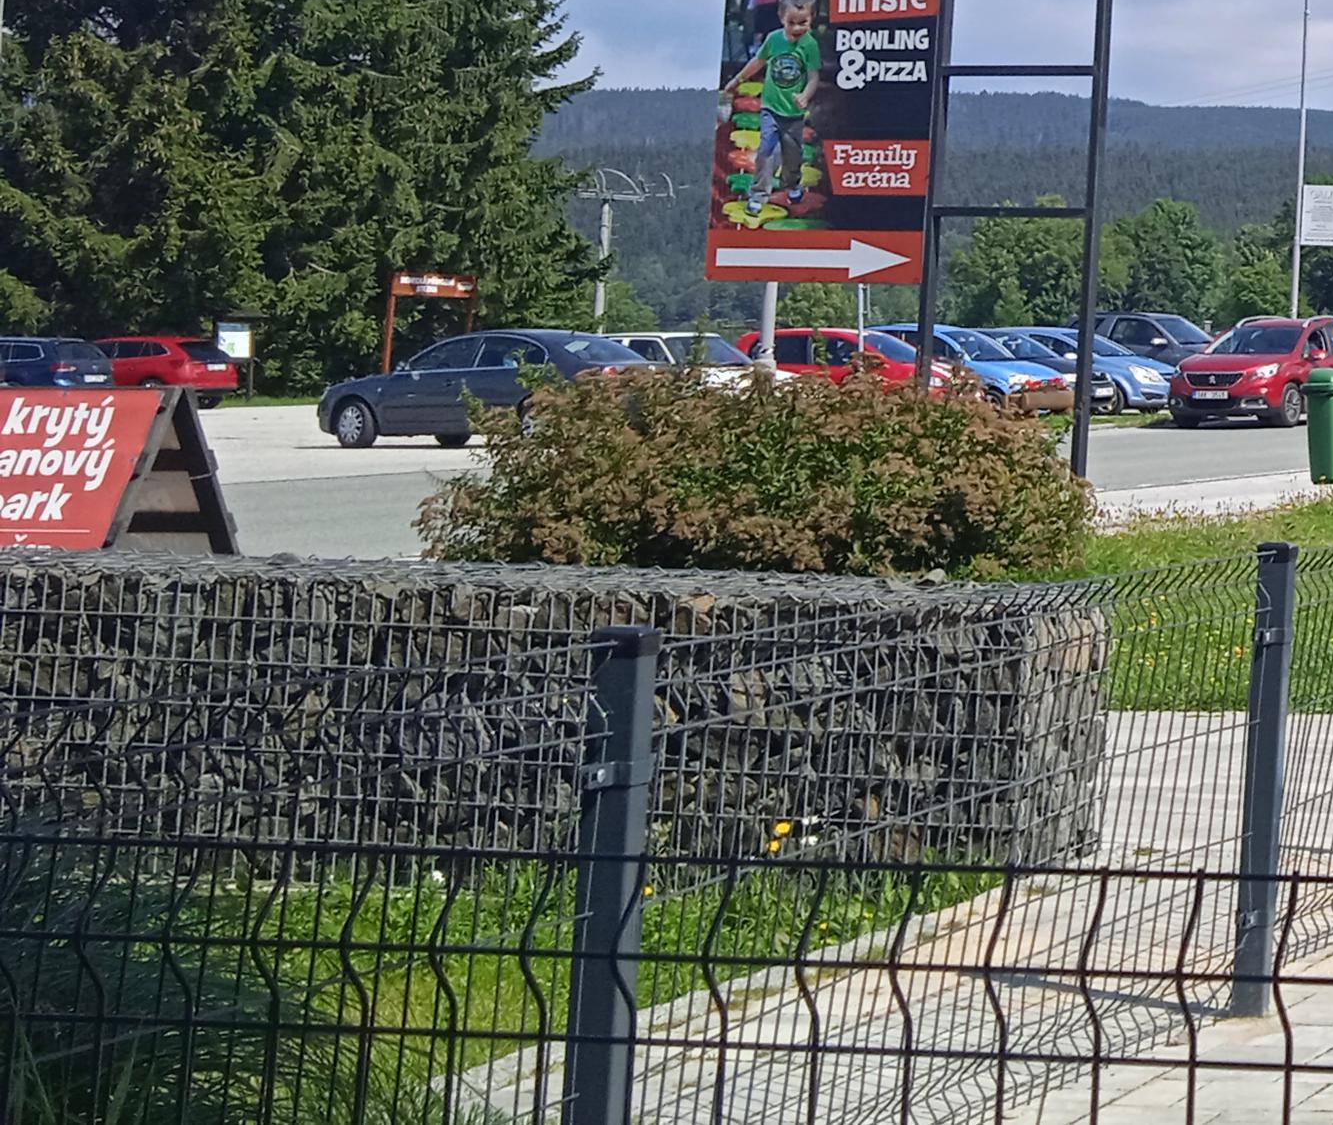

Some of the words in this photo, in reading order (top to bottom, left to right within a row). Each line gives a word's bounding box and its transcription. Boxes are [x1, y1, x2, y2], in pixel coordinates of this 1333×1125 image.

[836, 28, 929, 51] BOWLING
[866, 61, 928, 82] PIZZA
[833, 144, 917, 169] Family
[842, 166, 911, 188] aréna
[1, 395, 115, 448] krytý
[0, 438, 115, 491] anový
[0, 483, 72, 521] ark
